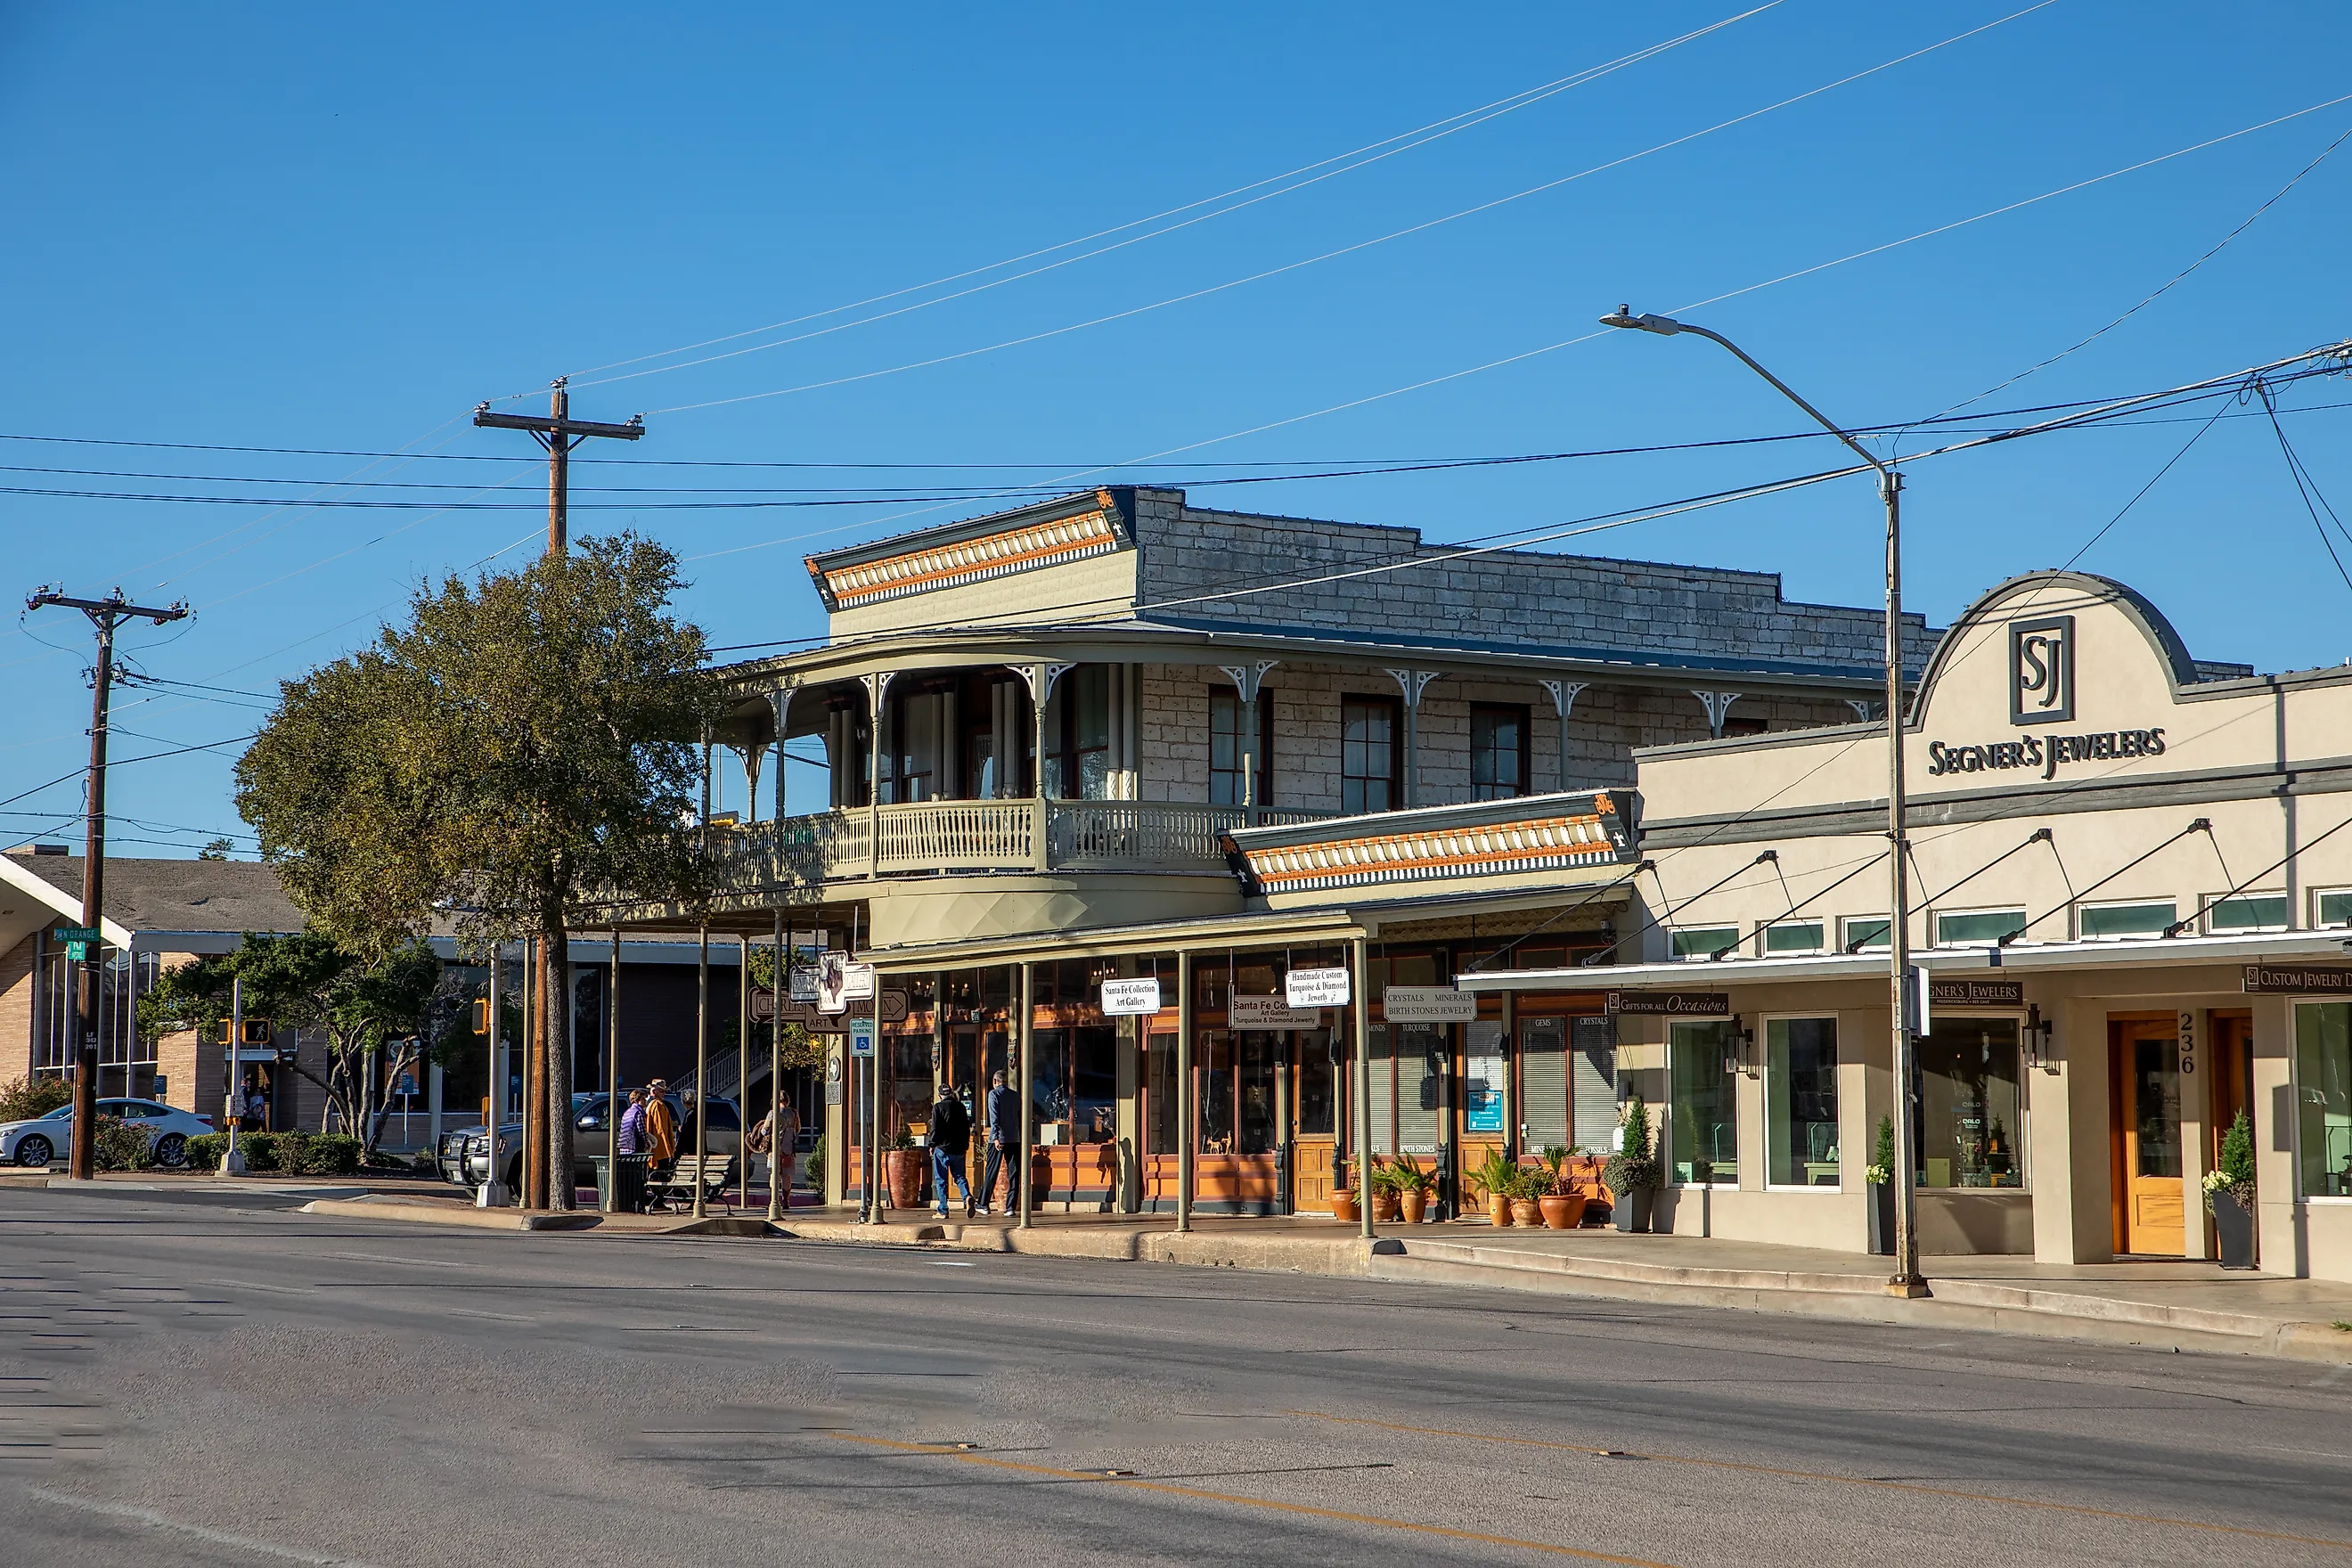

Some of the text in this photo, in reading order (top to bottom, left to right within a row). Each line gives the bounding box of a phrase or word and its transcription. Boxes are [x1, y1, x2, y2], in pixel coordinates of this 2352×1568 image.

[2021, 635, 2062, 708] SJ
[1928, 727, 2166, 780] SEGNER'S JEWELERS
[63, 929, 95, 939] N ORANGE
[1292, 971, 1343, 981] Handmade Custom
[2260, 970, 2302, 986] CUSTOM
[2304, 971, 2343, 990] JEWELRY
[1105, 984, 1156, 995] Santa Fe Collection
[1289, 981, 1347, 994] Turquoise & Diamond
[1929, 982, 2018, 1000] GNER'S JEWELERS
[1115, 996, 1147, 1008] Art Gallery
[1387, 993, 1473, 1002] CRYSTALS MINERALS
[1621, 999, 1640, 1010] GIFTS
[1666, 994, 1727, 1011] Occasions
[758, 997, 804, 1013] CHRLES
[1234, 1000, 1258, 1010] Santa
[1260, 1000, 1271, 1009] Fe
[1388, 1007, 1473, 1015] BIRTH STONES JEWELRY
[809, 1018, 828, 1027] ART
[1535, 1017, 1609, 1027] GEMS CRYSTALS
[1401, 1023, 1431, 1033] TURQUOISE
[2180, 1013, 2194, 1074] 236
[1400, 1145, 1435, 1153] BIRTH STONES
[1585, 1146, 1609, 1155] FOSSILS
